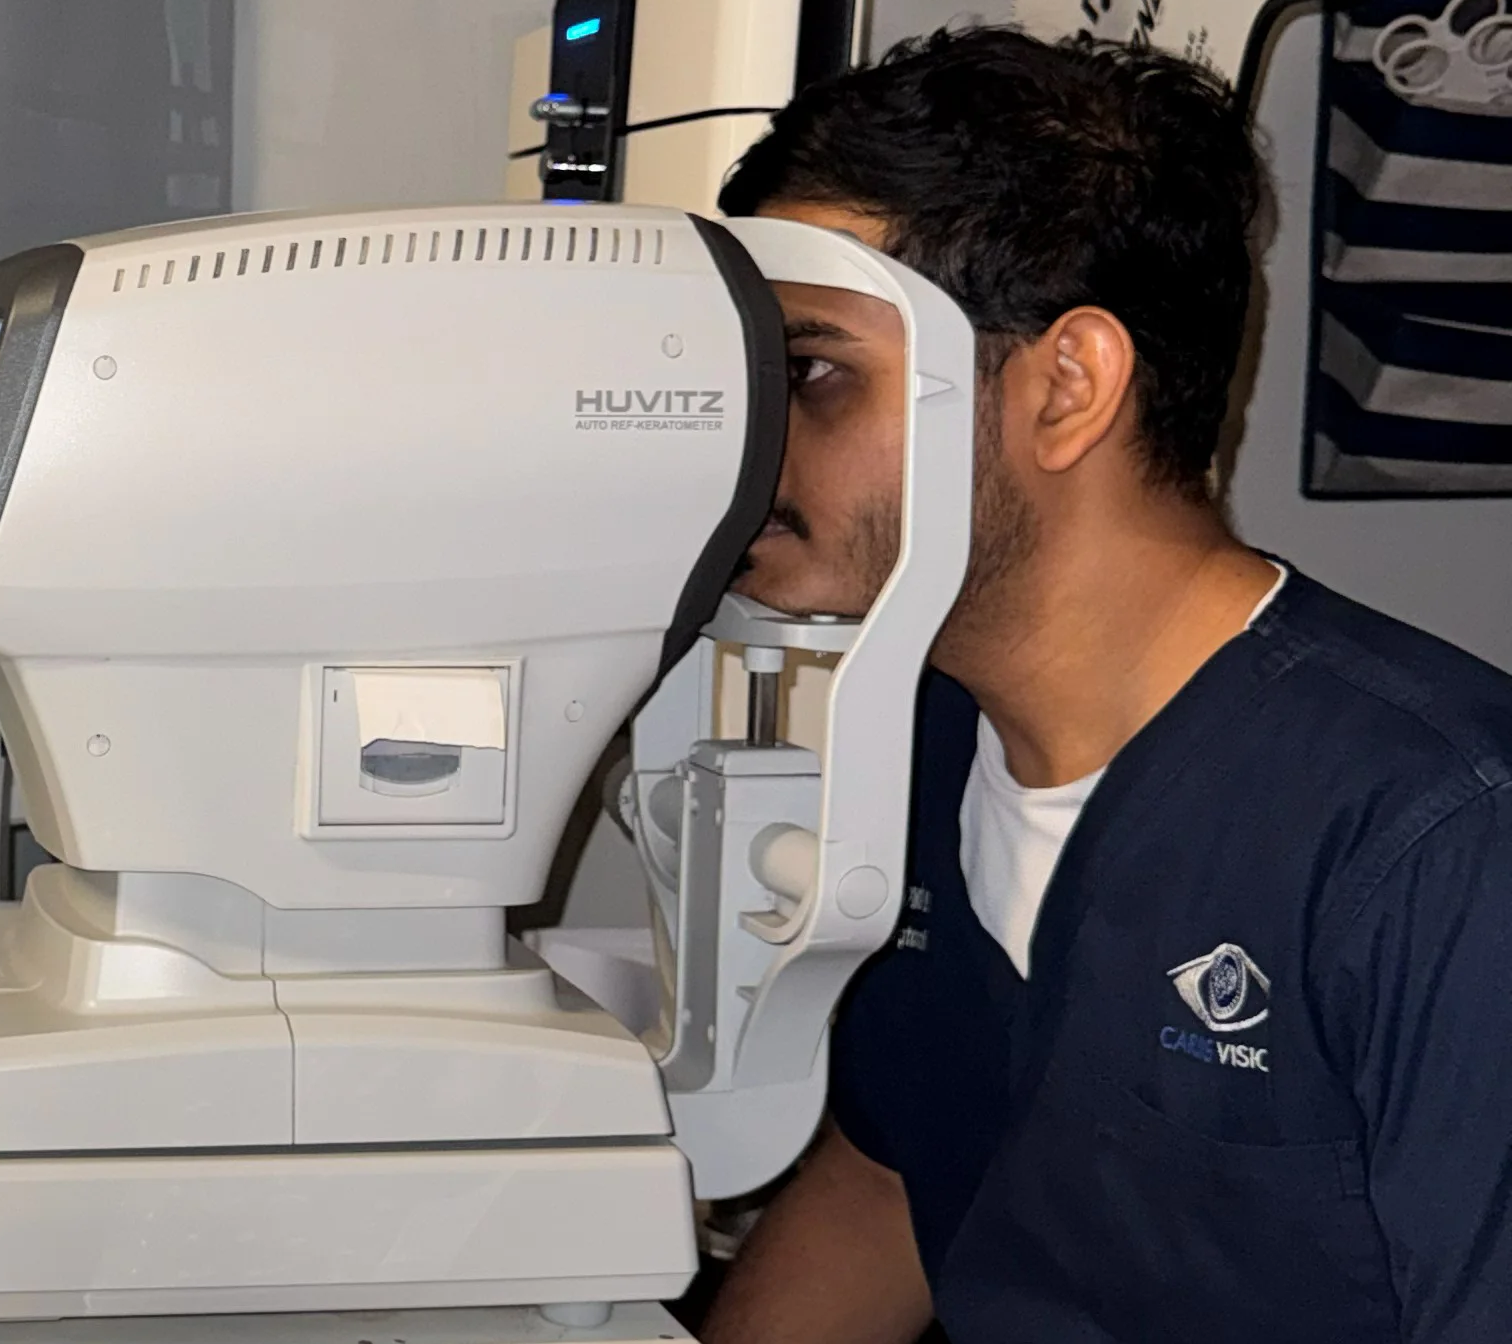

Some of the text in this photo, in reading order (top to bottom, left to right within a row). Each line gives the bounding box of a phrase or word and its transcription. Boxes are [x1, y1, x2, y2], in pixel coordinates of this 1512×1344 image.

[575, 390, 724, 413] HUVITZ
[575, 419, 724, 431] AUTO REF-KERATOMETER
